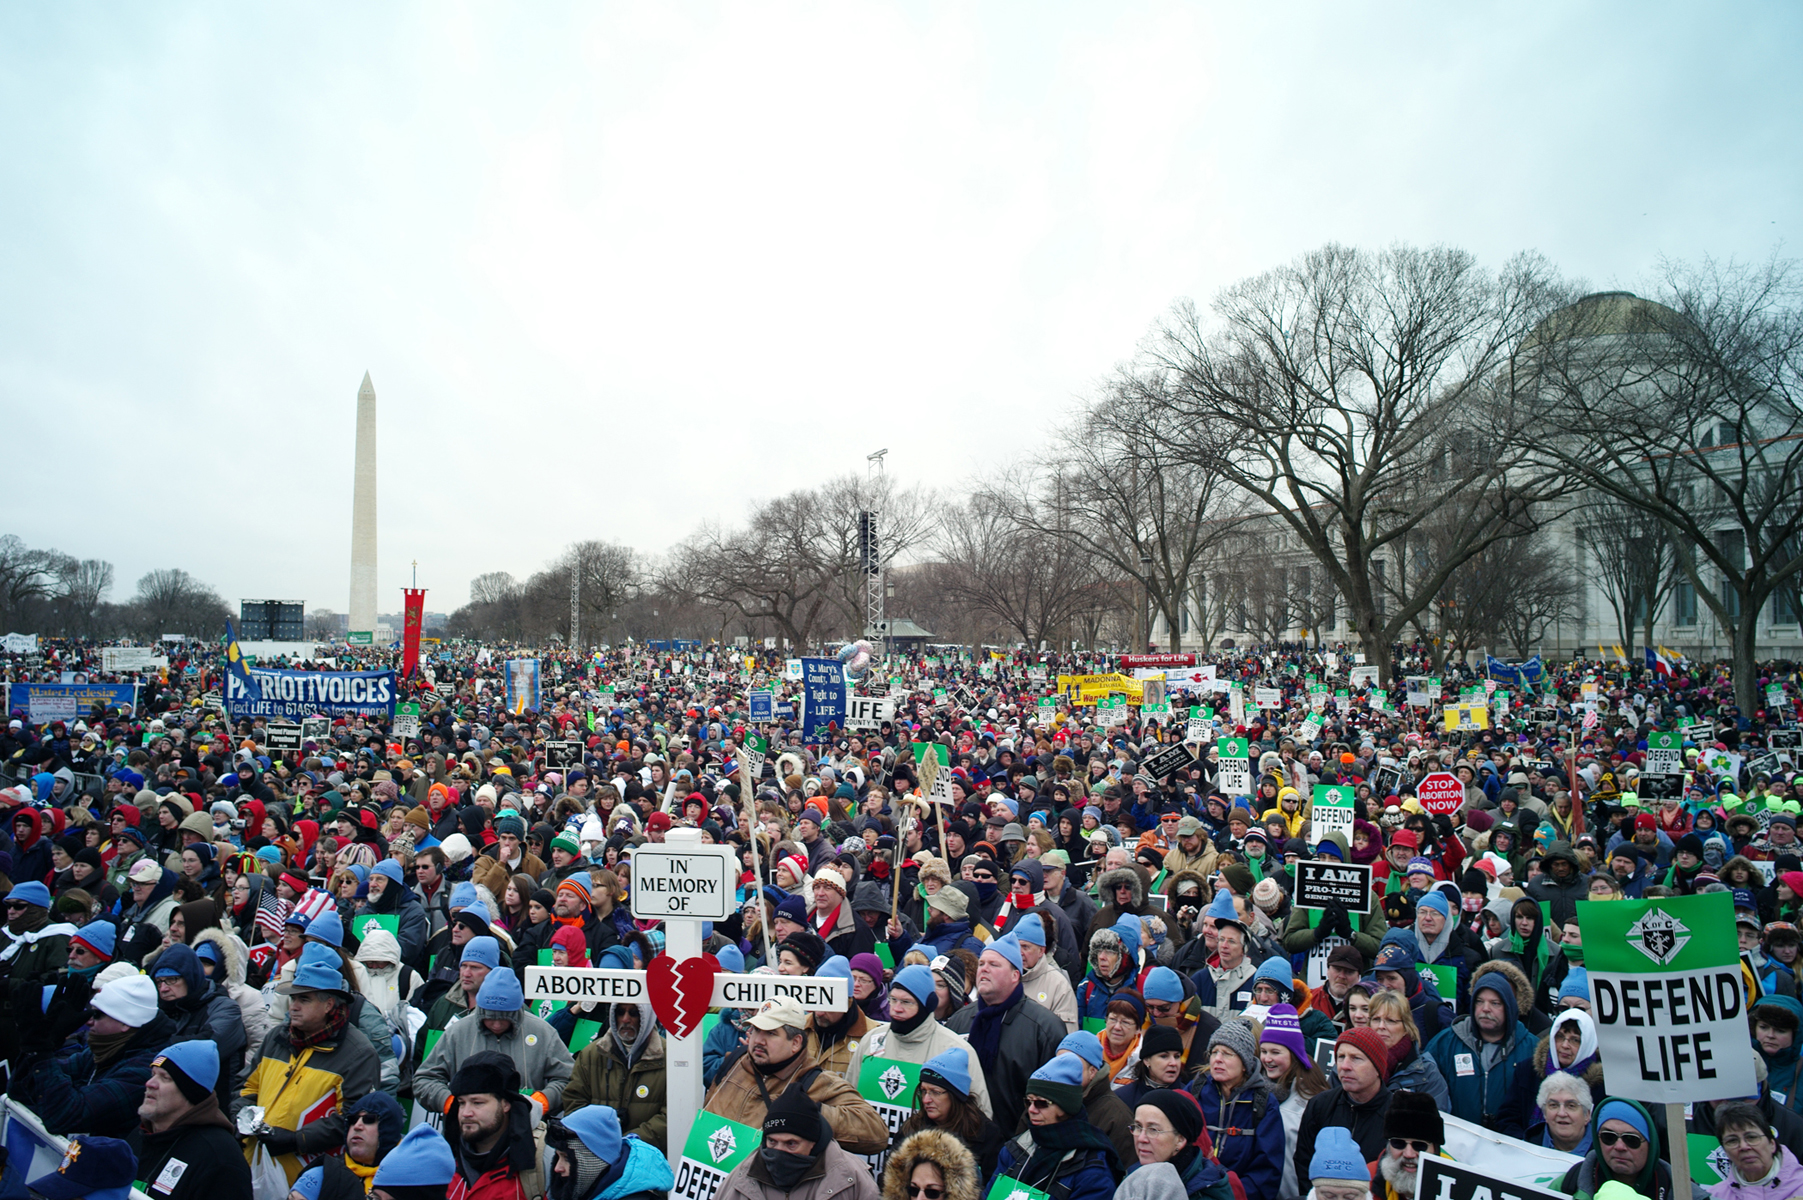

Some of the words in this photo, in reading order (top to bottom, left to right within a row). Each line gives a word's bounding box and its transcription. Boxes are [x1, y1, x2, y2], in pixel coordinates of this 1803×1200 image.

[1174, 654, 1189, 662] Life
[808, 663, 817, 673] St.
[820, 664, 837, 676] Mary's
[1167, 670, 1187, 679] LIFE
[808, 674, 827, 685] County,
[829, 675, 840, 684] MD
[1084, 676, 1120, 684] MADONNA
[316, 675, 391, 703] VOICES
[1170, 682, 1205, 691] Runners
[812, 690, 827, 702] Right
[829, 691, 838, 700] to
[1083, 694, 1106, 703] Wants
[1127, 694, 1144, 704] Resp
[230, 701, 249, 715] Text
[251, 701, 271, 715] LIFE
[273, 703, 283, 715] to
[285, 703, 318, 716] 67463
[360, 704, 389, 718] more!
[815, 705, 836, 716] LIFE
[845, 701, 884, 720] IFE
[1039, 706, 1055, 714] DEFEND
[1097, 709, 1114, 717] DEFEND
[395, 715, 418, 725] DEFEND
[1189, 719, 1212, 730] DEFEND
[399, 725, 412, 734] LIFE
[1193, 729, 1205, 739] LIFE
[1149, 760, 1157, 768] I
[1159, 748, 1182, 764] AM
[1648, 750, 1680, 762] DEFEND
[1220, 759, 1249, 773] DEFEND
[1654, 762, 1671, 773] LIFE
[1227, 774, 1242, 788] LIFE
[1426, 780, 1455, 790] STOP
[1420, 789, 1462, 800] ABORTION
[1427, 800, 1457, 811] NOW
[1313, 807, 1353, 824] DEFEND
[670, 859, 688, 874] IN
[1305, 867, 1316, 880] I
[1320, 868, 1362, 884] AM
[640, 877, 718, 894] MEMORY
[1304, 885, 1361, 896] PRO-LIFE
[668, 896, 690, 911] OF
[1642, 922, 1650, 931] K
[1665, 920, 1673, 929] C
[1310, 938, 1351, 959] DEFE
[252, 950, 269, 966] ST
[535, 975, 642, 998] ABORTED
[722, 981, 834, 1006] CHILDREN
[1593, 972, 1741, 1027] DEFEND
[1635, 1031, 1717, 1082] LIFE
[675, 1161, 726, 1200] DEFE
